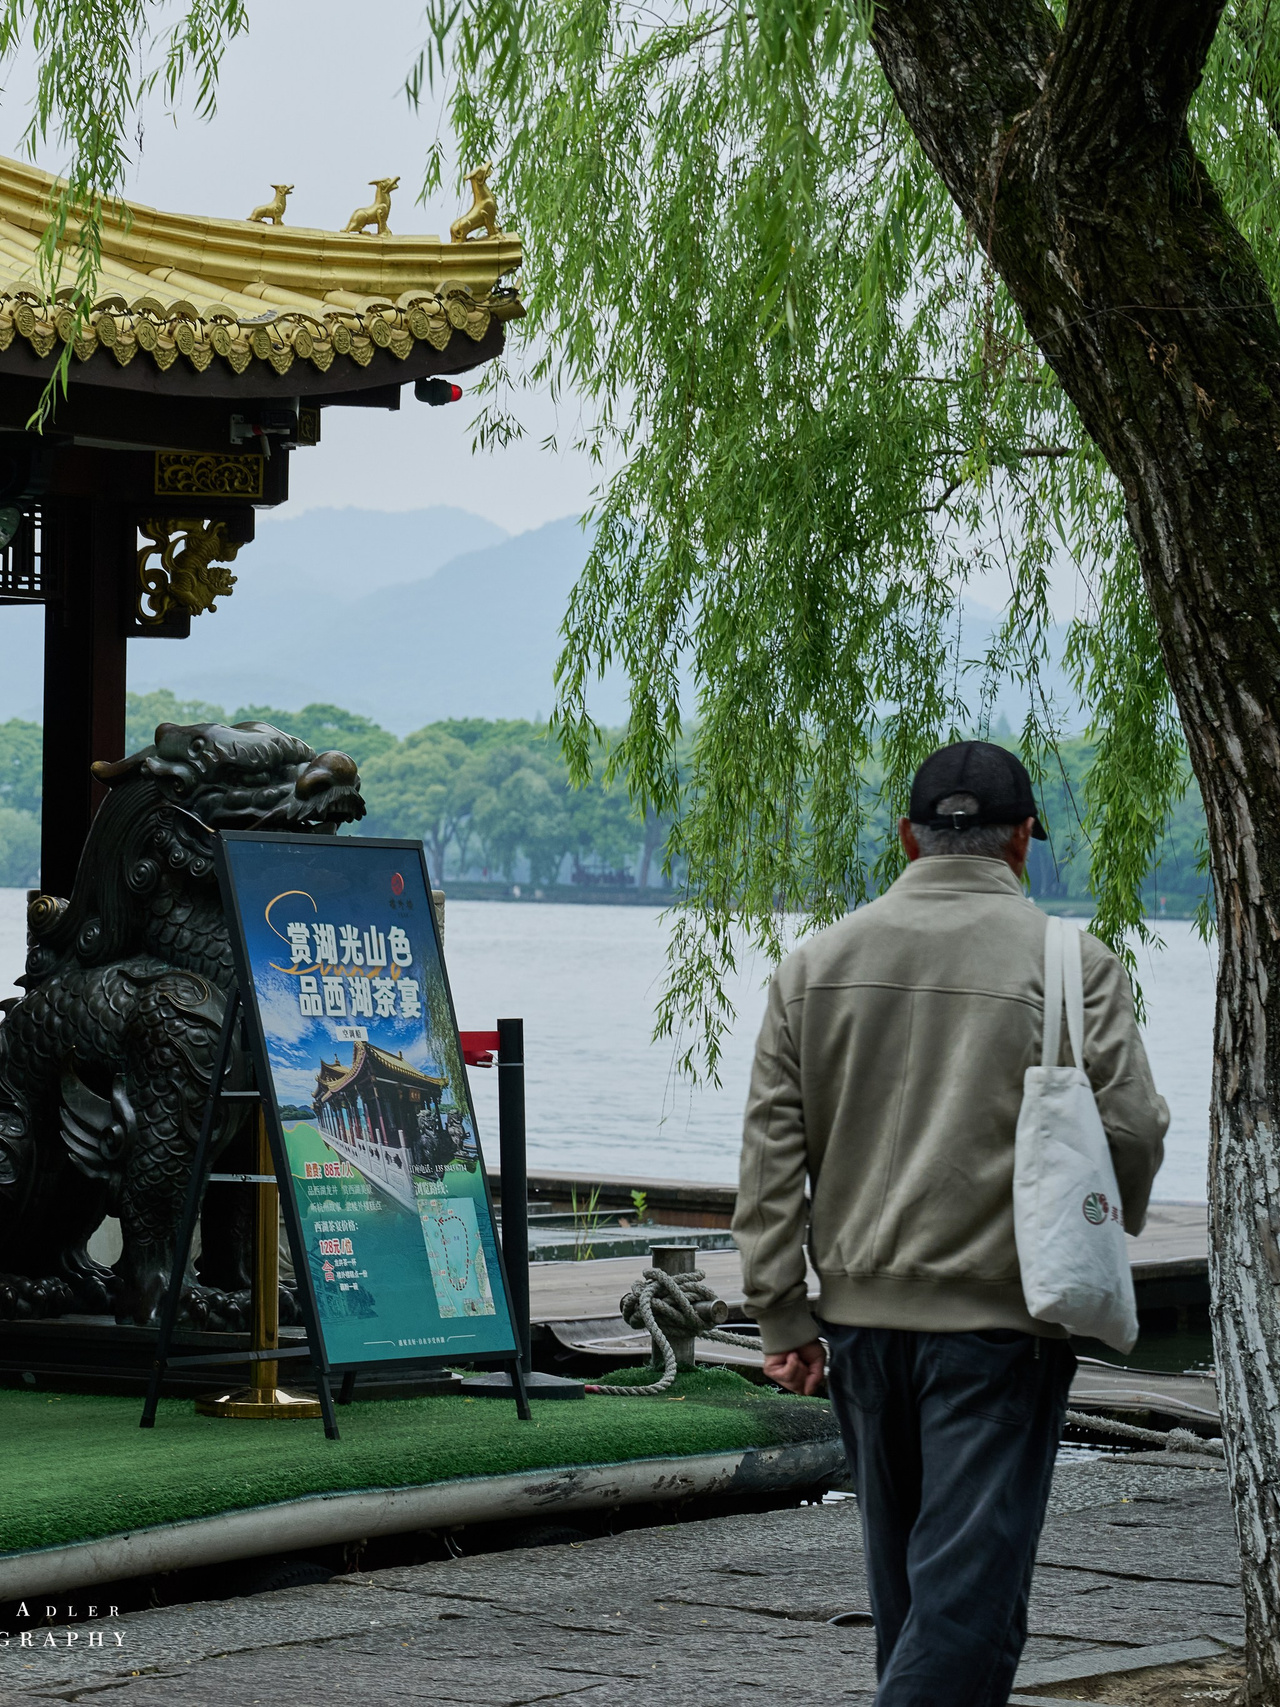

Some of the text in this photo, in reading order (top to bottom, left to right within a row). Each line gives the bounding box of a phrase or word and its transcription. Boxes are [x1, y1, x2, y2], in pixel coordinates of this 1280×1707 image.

[286, 922, 413, 967] 赏湖光山色
[299, 976, 421, 1019] 品西湖茶宴
[342, 1029, 362, 1039] 空调船
[324, 1161, 354, 1178] 88元/人
[319, 1238, 354, 1255] 128元/位
[322, 1260, 335, 1282] 含
